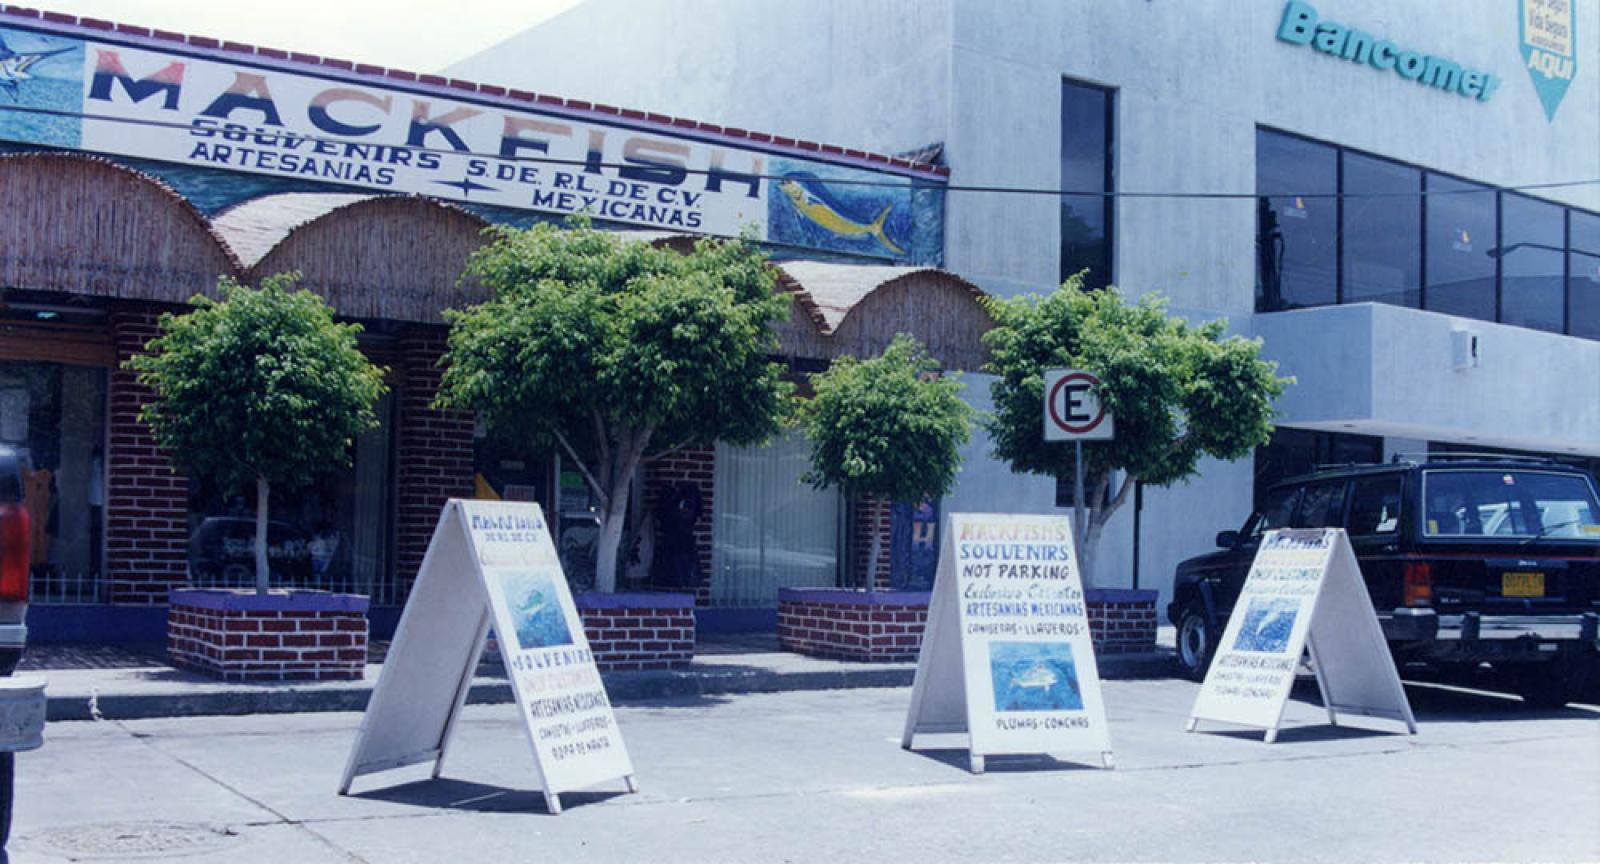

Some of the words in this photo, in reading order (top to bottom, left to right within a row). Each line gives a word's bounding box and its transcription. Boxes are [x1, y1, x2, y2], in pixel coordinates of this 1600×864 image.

[1276, 0, 1498, 102] Bancomer
[88, 47, 763, 199] MACKFISH
[190, 118, 442, 170] SOUVENIRS
[189, 140, 395, 185] ARTESANIAS
[532, 188, 702, 228] MEXICANAS
[1065, 384, 1091, 421] E
[959, 544, 1070, 561] SOUVENIRS
[963, 564, 993, 578] NOT
[999, 564, 1070, 580] PARKING
